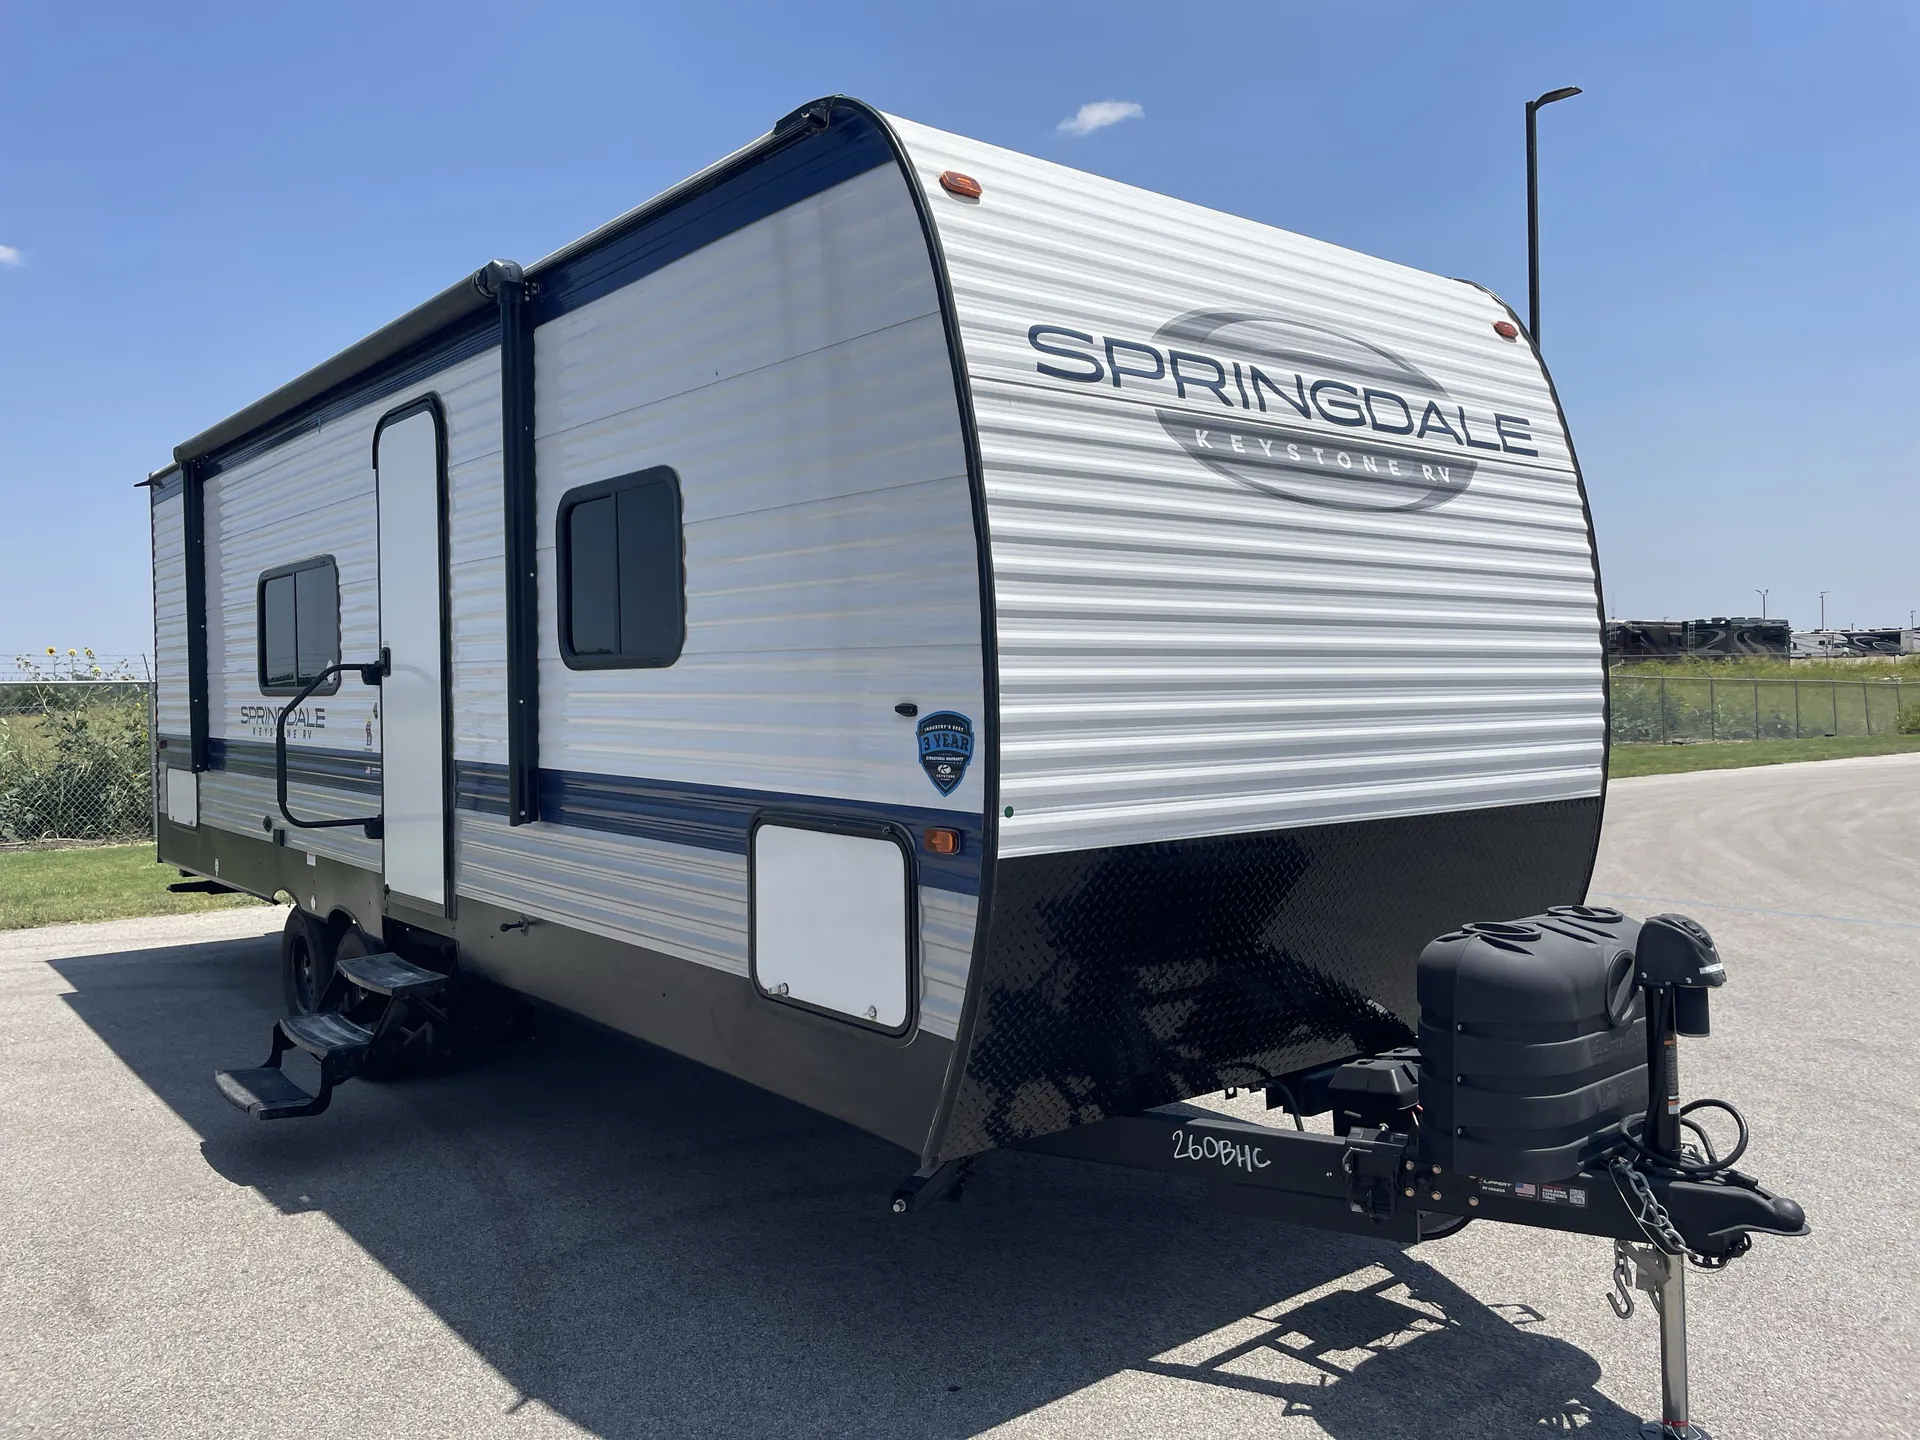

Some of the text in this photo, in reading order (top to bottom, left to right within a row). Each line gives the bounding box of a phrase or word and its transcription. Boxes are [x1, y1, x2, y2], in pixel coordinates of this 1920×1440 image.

[1027, 323, 1539, 458] SPRINGDALE
[1194, 428, 1451, 484] KEYSTONE RV
[253, 728, 312, 739] KEYSNE RV
[923, 733, 968, 751] 3 YEAR
[1172, 1129, 1272, 1173] 260BHC
